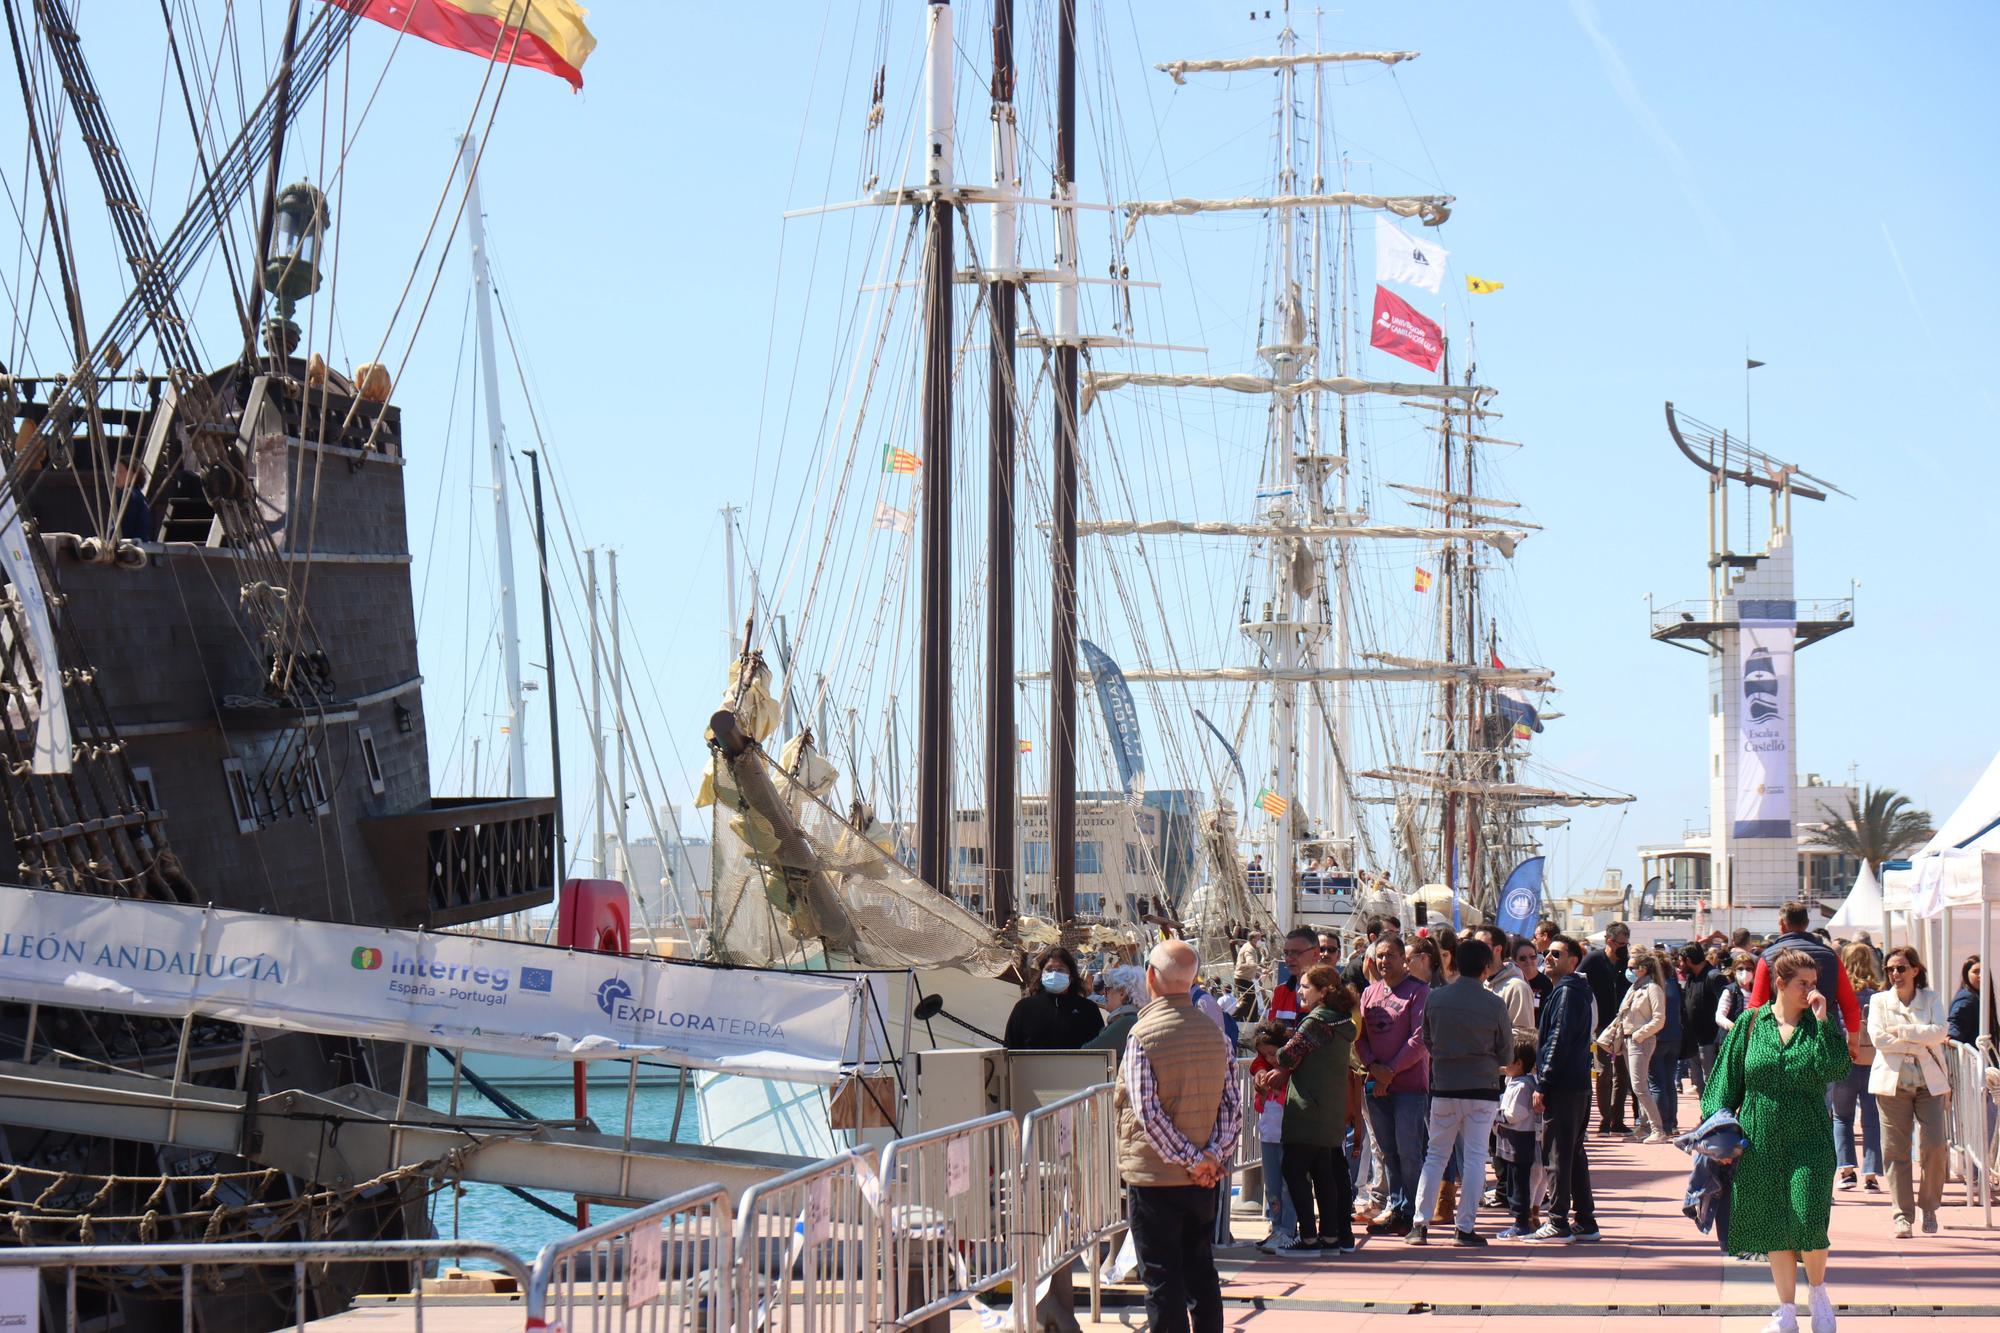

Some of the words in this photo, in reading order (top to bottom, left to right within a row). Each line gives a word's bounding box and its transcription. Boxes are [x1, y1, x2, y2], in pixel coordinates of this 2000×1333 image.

[1106, 674, 1134, 756] PASCUAL
[1744, 739, 1785, 752] Castelló
[1749, 728, 1773, 738] Escala
[1, 932, 86, 964] LEÓN
[93, 944, 283, 984] ANDALUCÍA
[391, 951, 510, 992] Interreg
[389, 980, 436, 997] España
[450, 988, 507, 1007] Portugal
[617, 1004, 785, 1039] EXPLORATERRA
